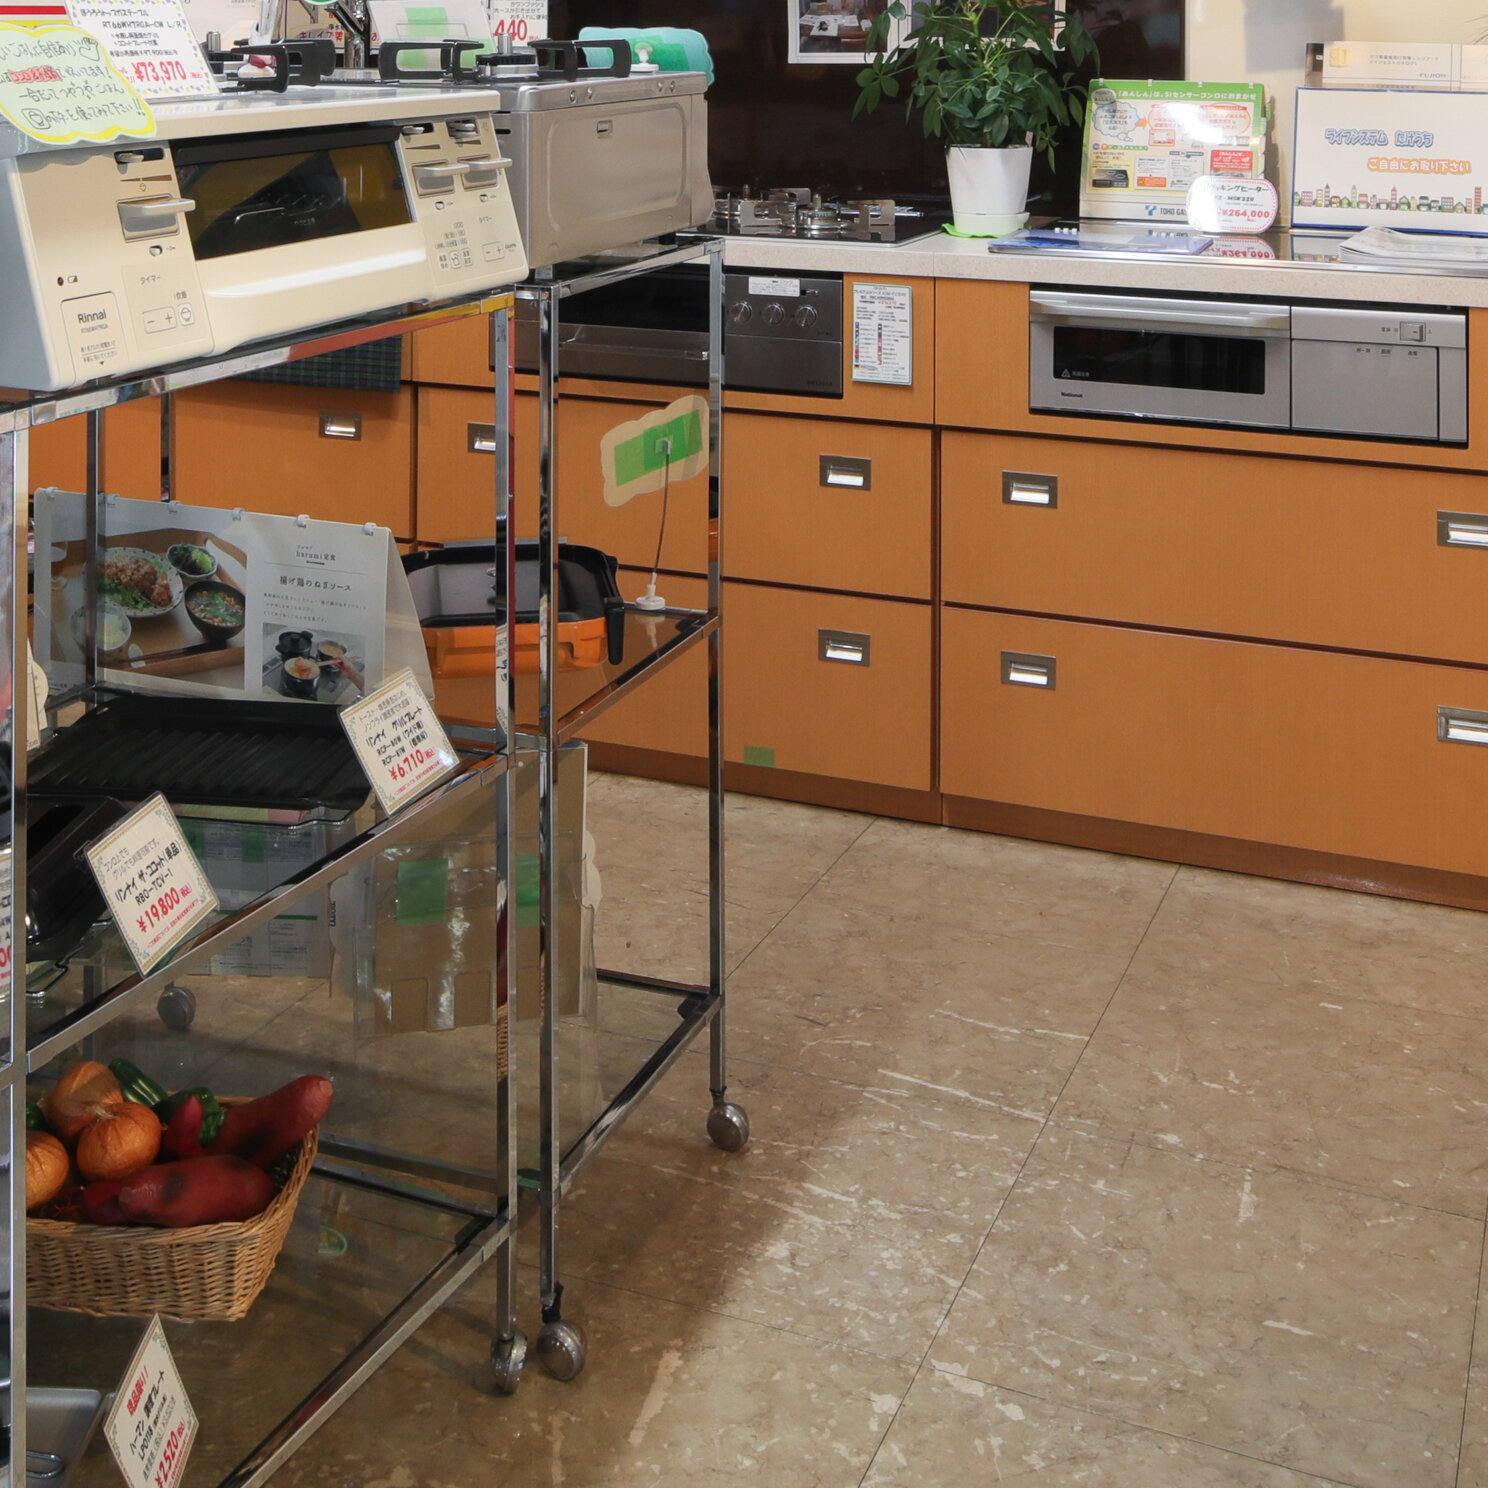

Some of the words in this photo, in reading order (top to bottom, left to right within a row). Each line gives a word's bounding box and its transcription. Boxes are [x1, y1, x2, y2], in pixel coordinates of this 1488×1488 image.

[135, 61, 188, 85] ¥73,970
[1324, 128, 1388, 146] ライフシステム
[1366, 157, 1472, 174] ご自由にお取り下さい
[77, 309, 107, 324] Rinnai
[136, 886, 181, 933] ¥19,800
